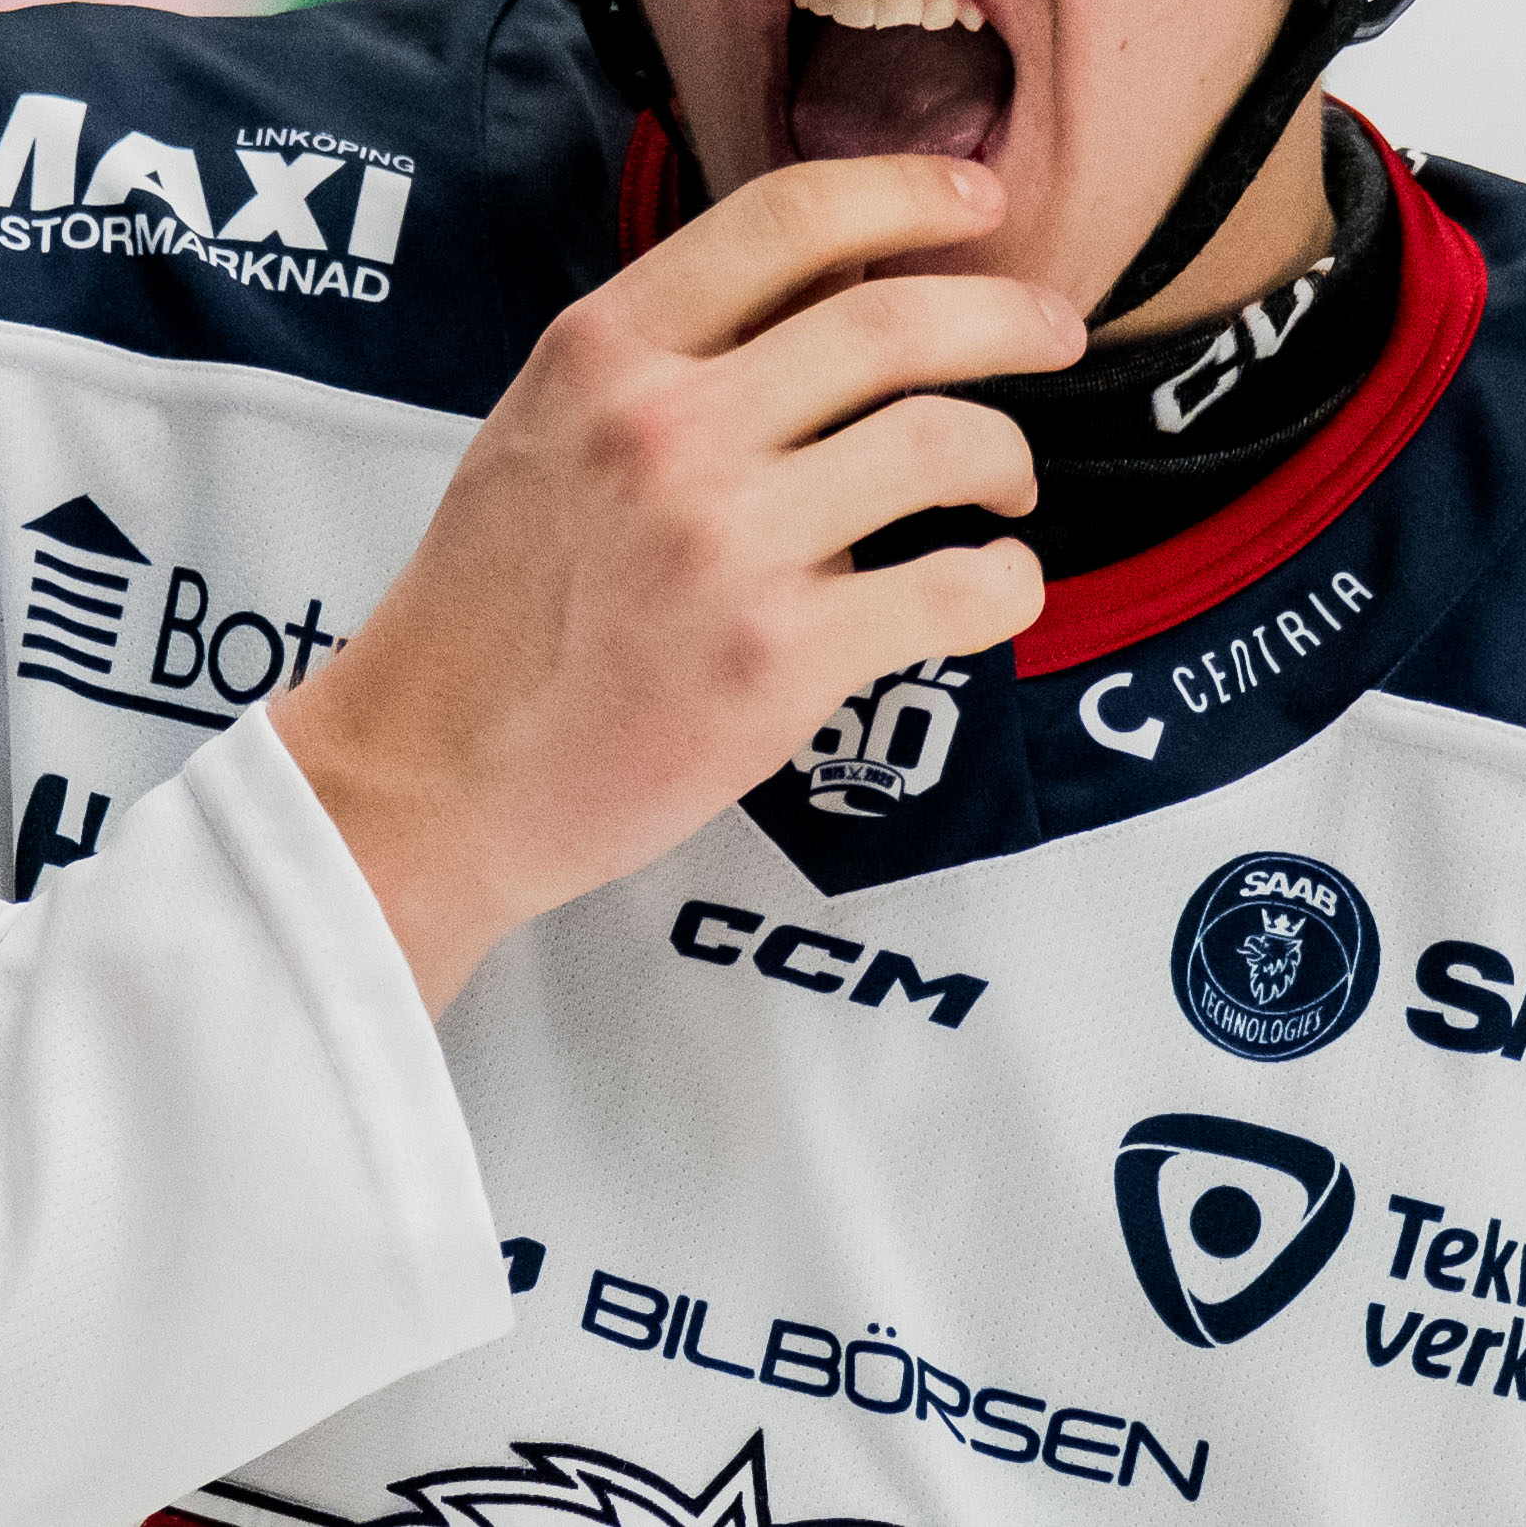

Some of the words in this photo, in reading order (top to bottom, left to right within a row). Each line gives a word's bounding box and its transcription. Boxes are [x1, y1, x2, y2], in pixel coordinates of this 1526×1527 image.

[235, 127, 416, 175] LINKÖPING
[150, 565, 350, 706] Bot
[1172, 571, 1374, 713] CENTRIA
[1239, 870, 1338, 917] SAAB
[667, 898, 990, 1030] CCM
[1200, 981, 1324, 1045] TECHNOLOGIES
[580, 1267, 1211, 1503] BILBÖRSEN
